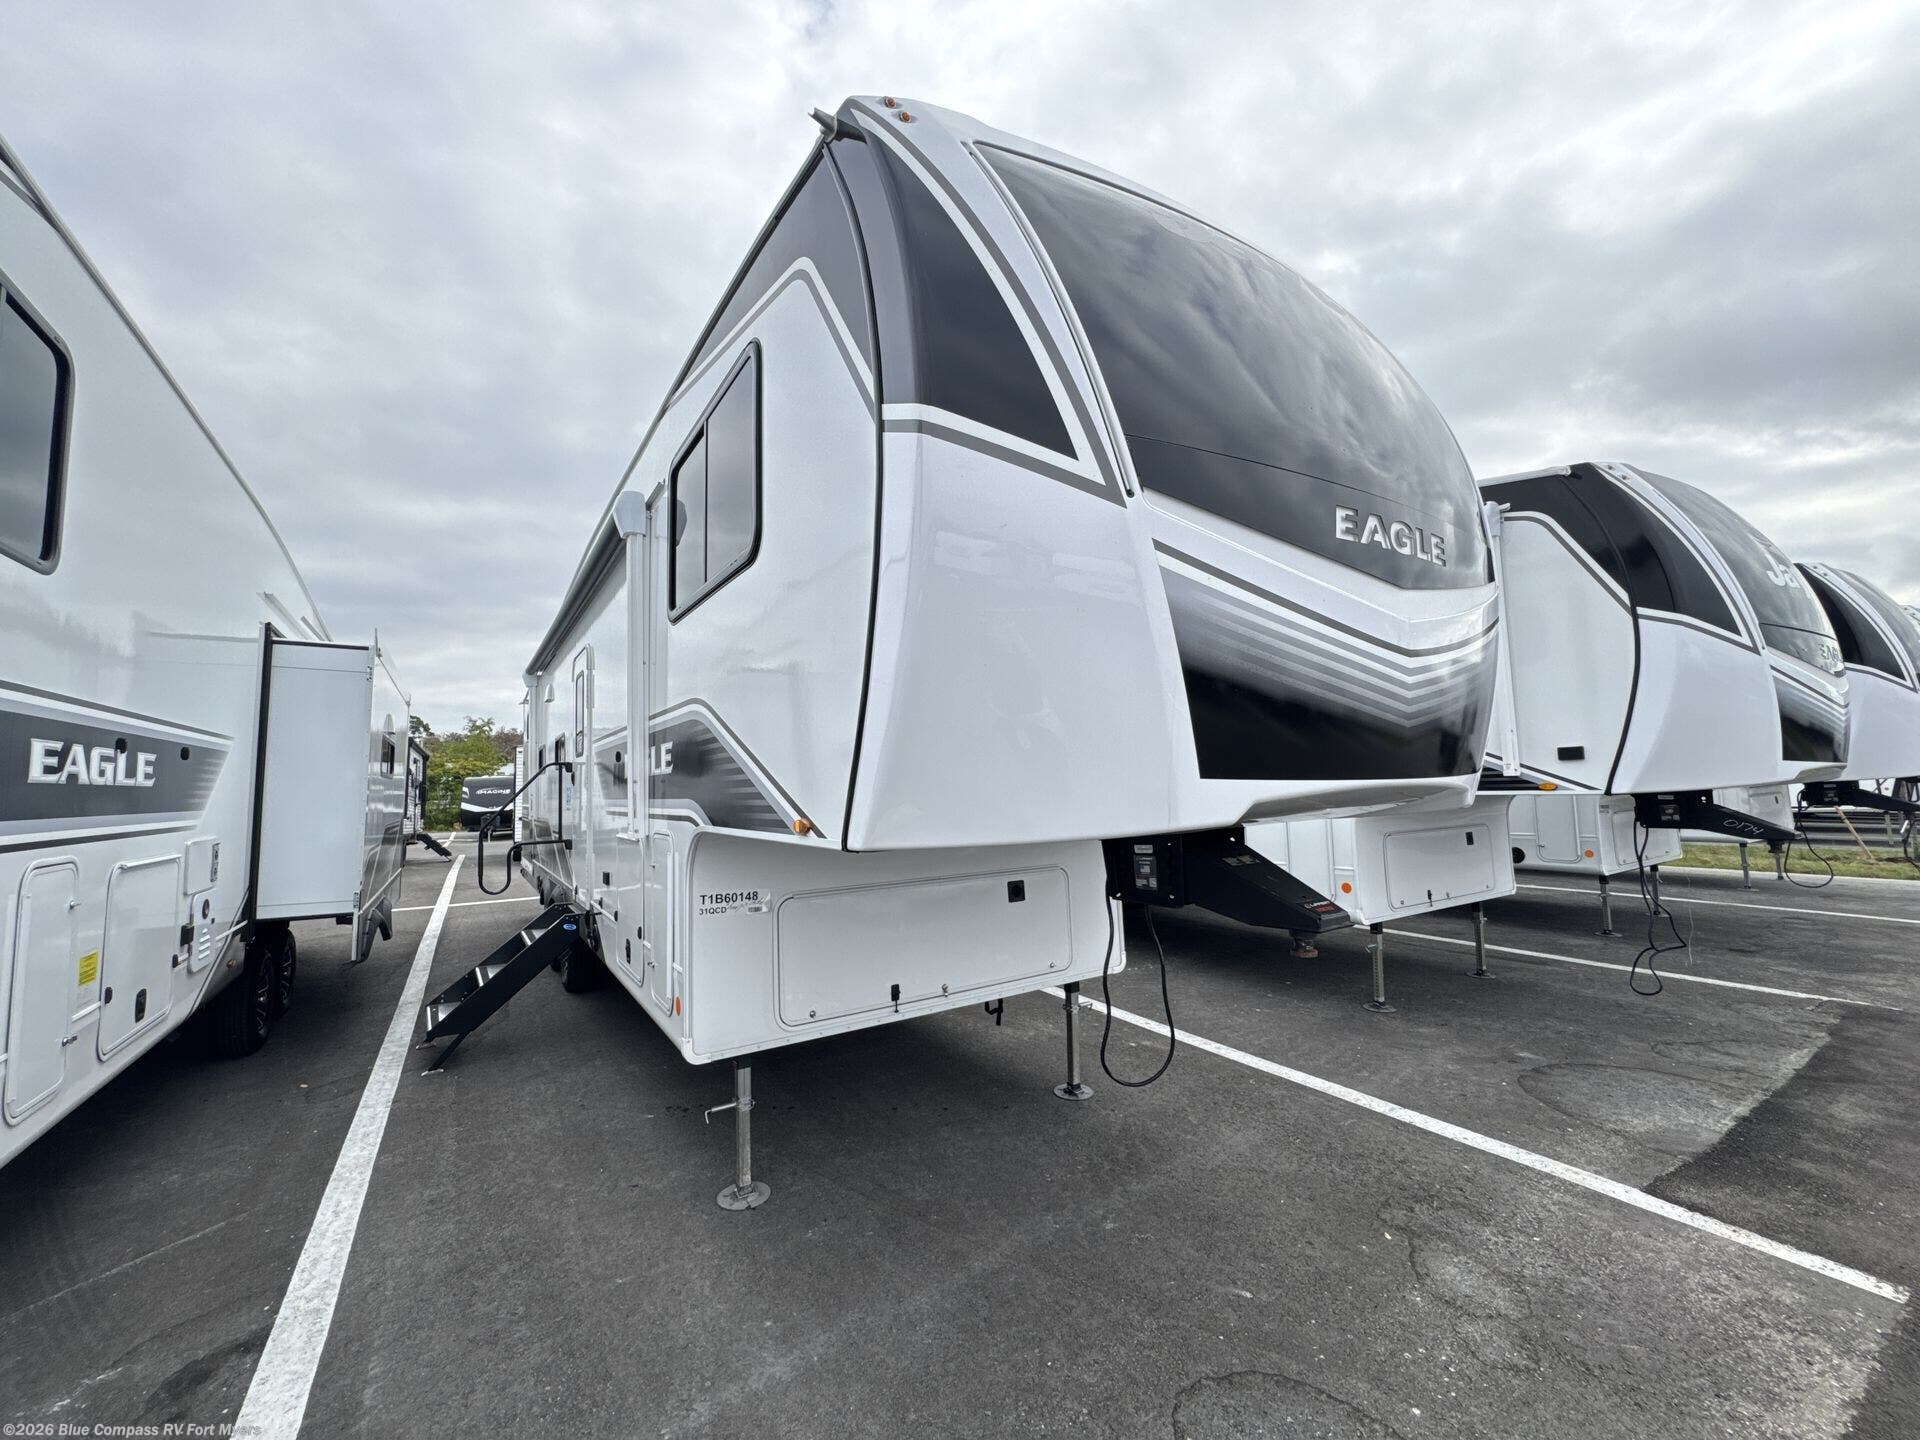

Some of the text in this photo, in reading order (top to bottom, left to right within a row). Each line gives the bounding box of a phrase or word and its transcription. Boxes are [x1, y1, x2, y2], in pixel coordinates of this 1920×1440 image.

[1335, 504, 1446, 567] EAGLE
[27, 738, 157, 787] EAGLE
[699, 890, 759, 905] T1B60148
[699, 906, 727, 916] 31QCD
